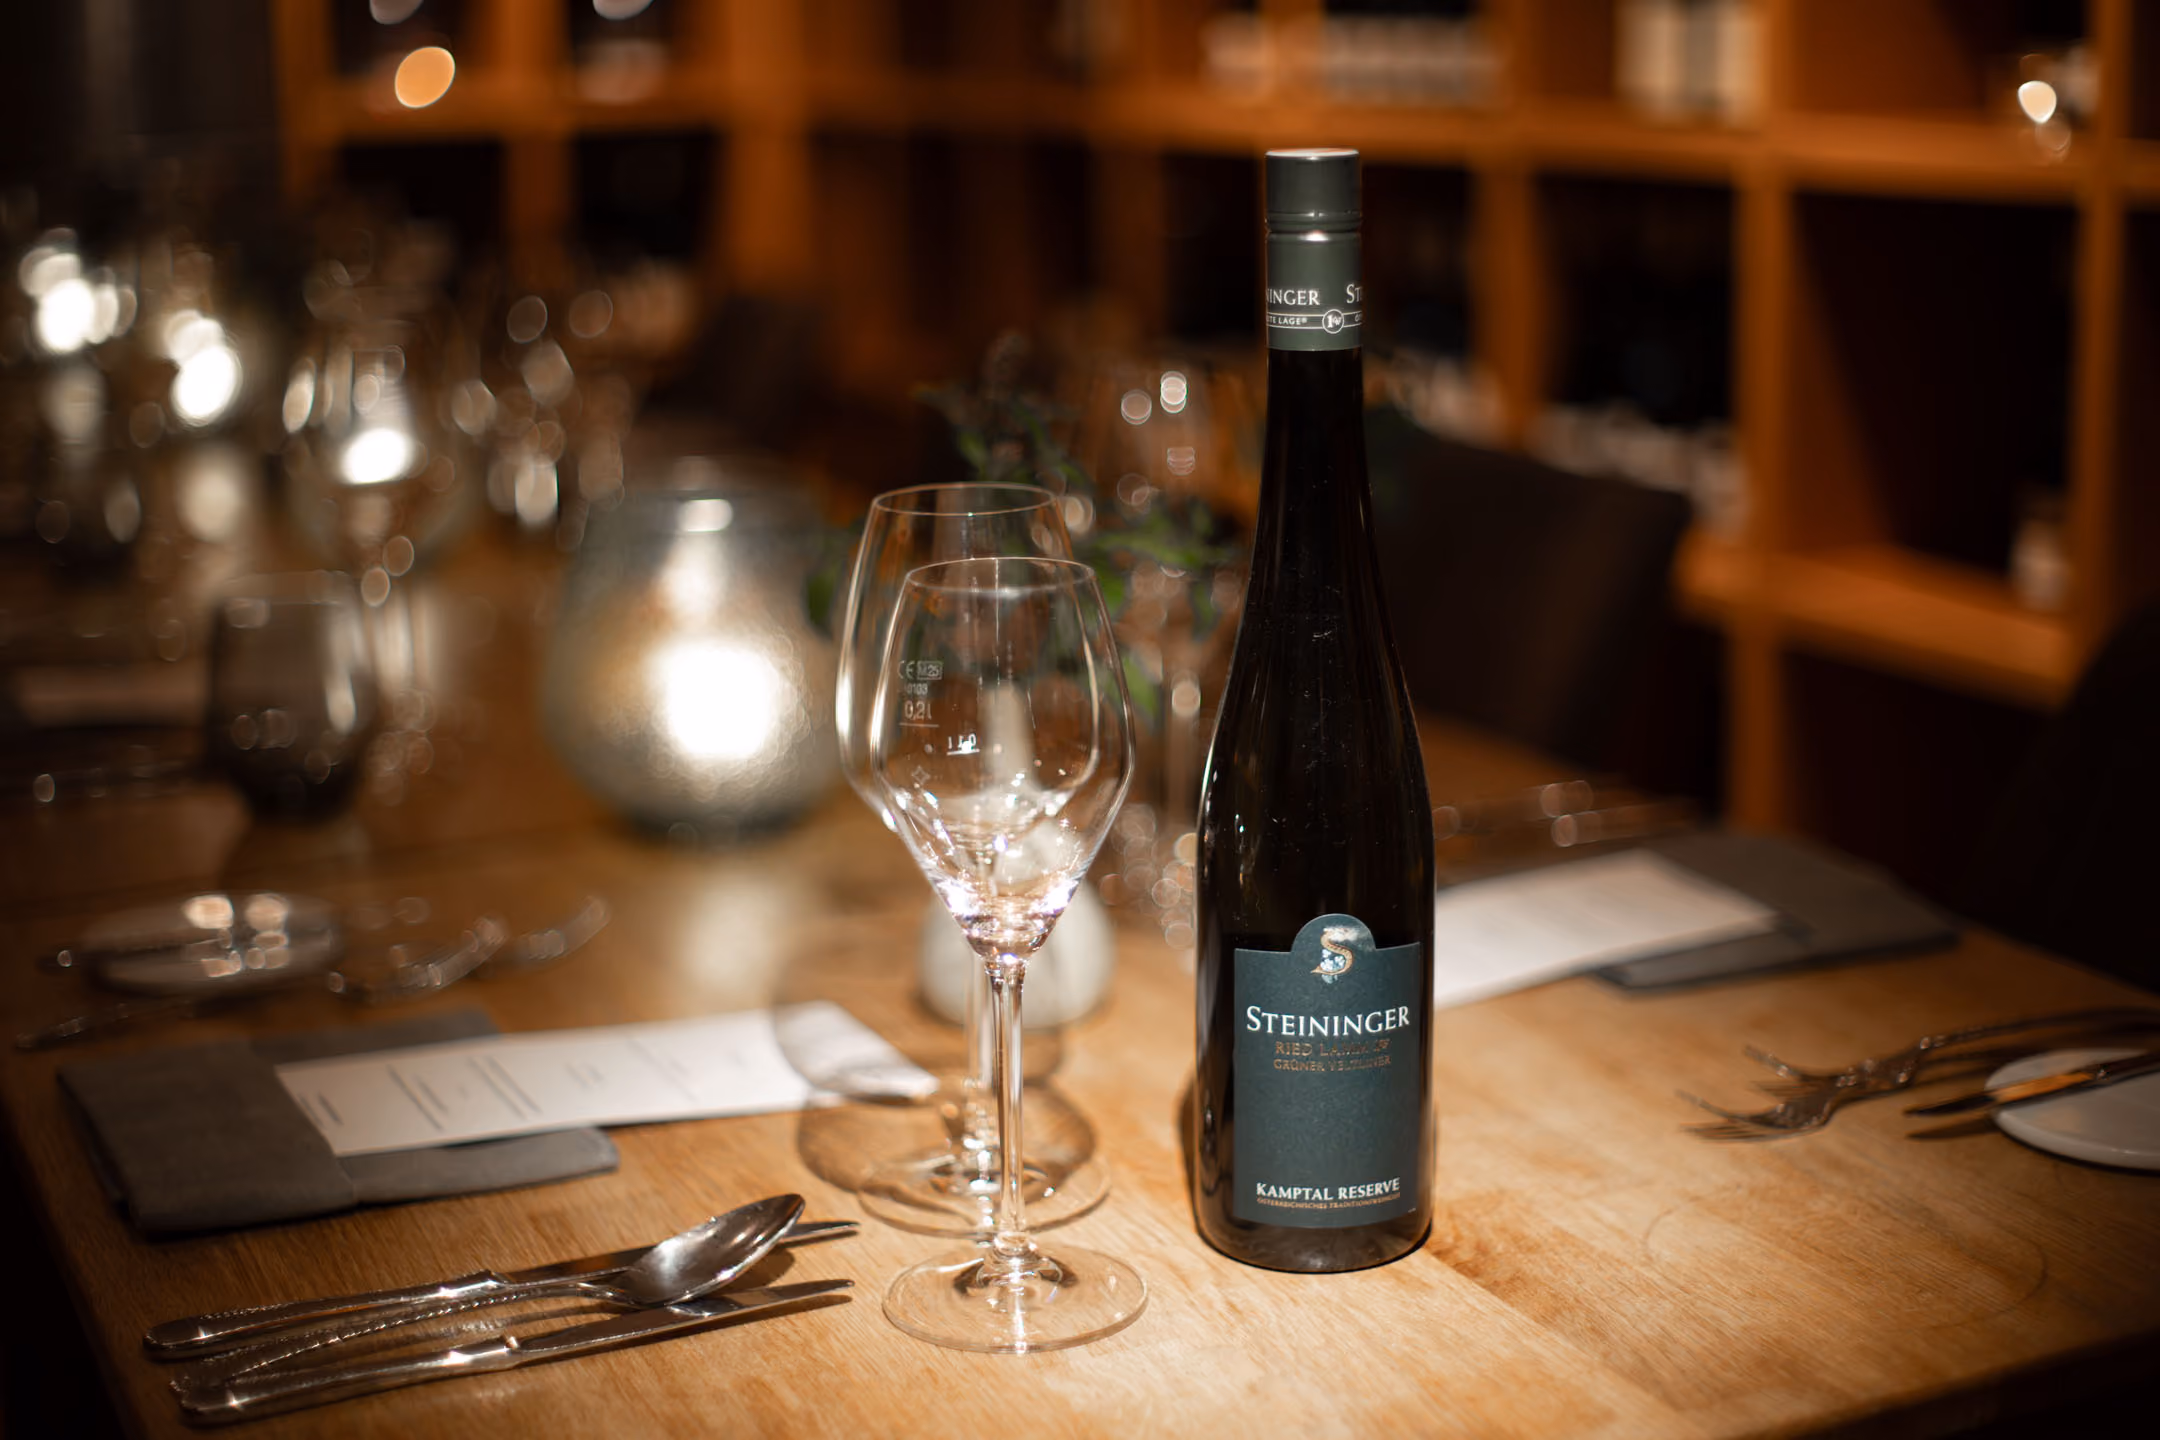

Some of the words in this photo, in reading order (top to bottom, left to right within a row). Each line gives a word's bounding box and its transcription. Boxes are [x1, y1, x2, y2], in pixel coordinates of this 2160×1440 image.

[1246, 1005, 1411, 1037] STEININGER
[1275, 1041, 1313, 1057] RIED
[1256, 1182, 1334, 1200] KAMPTAL
[1337, 1177, 1400, 1199] RESERVE
